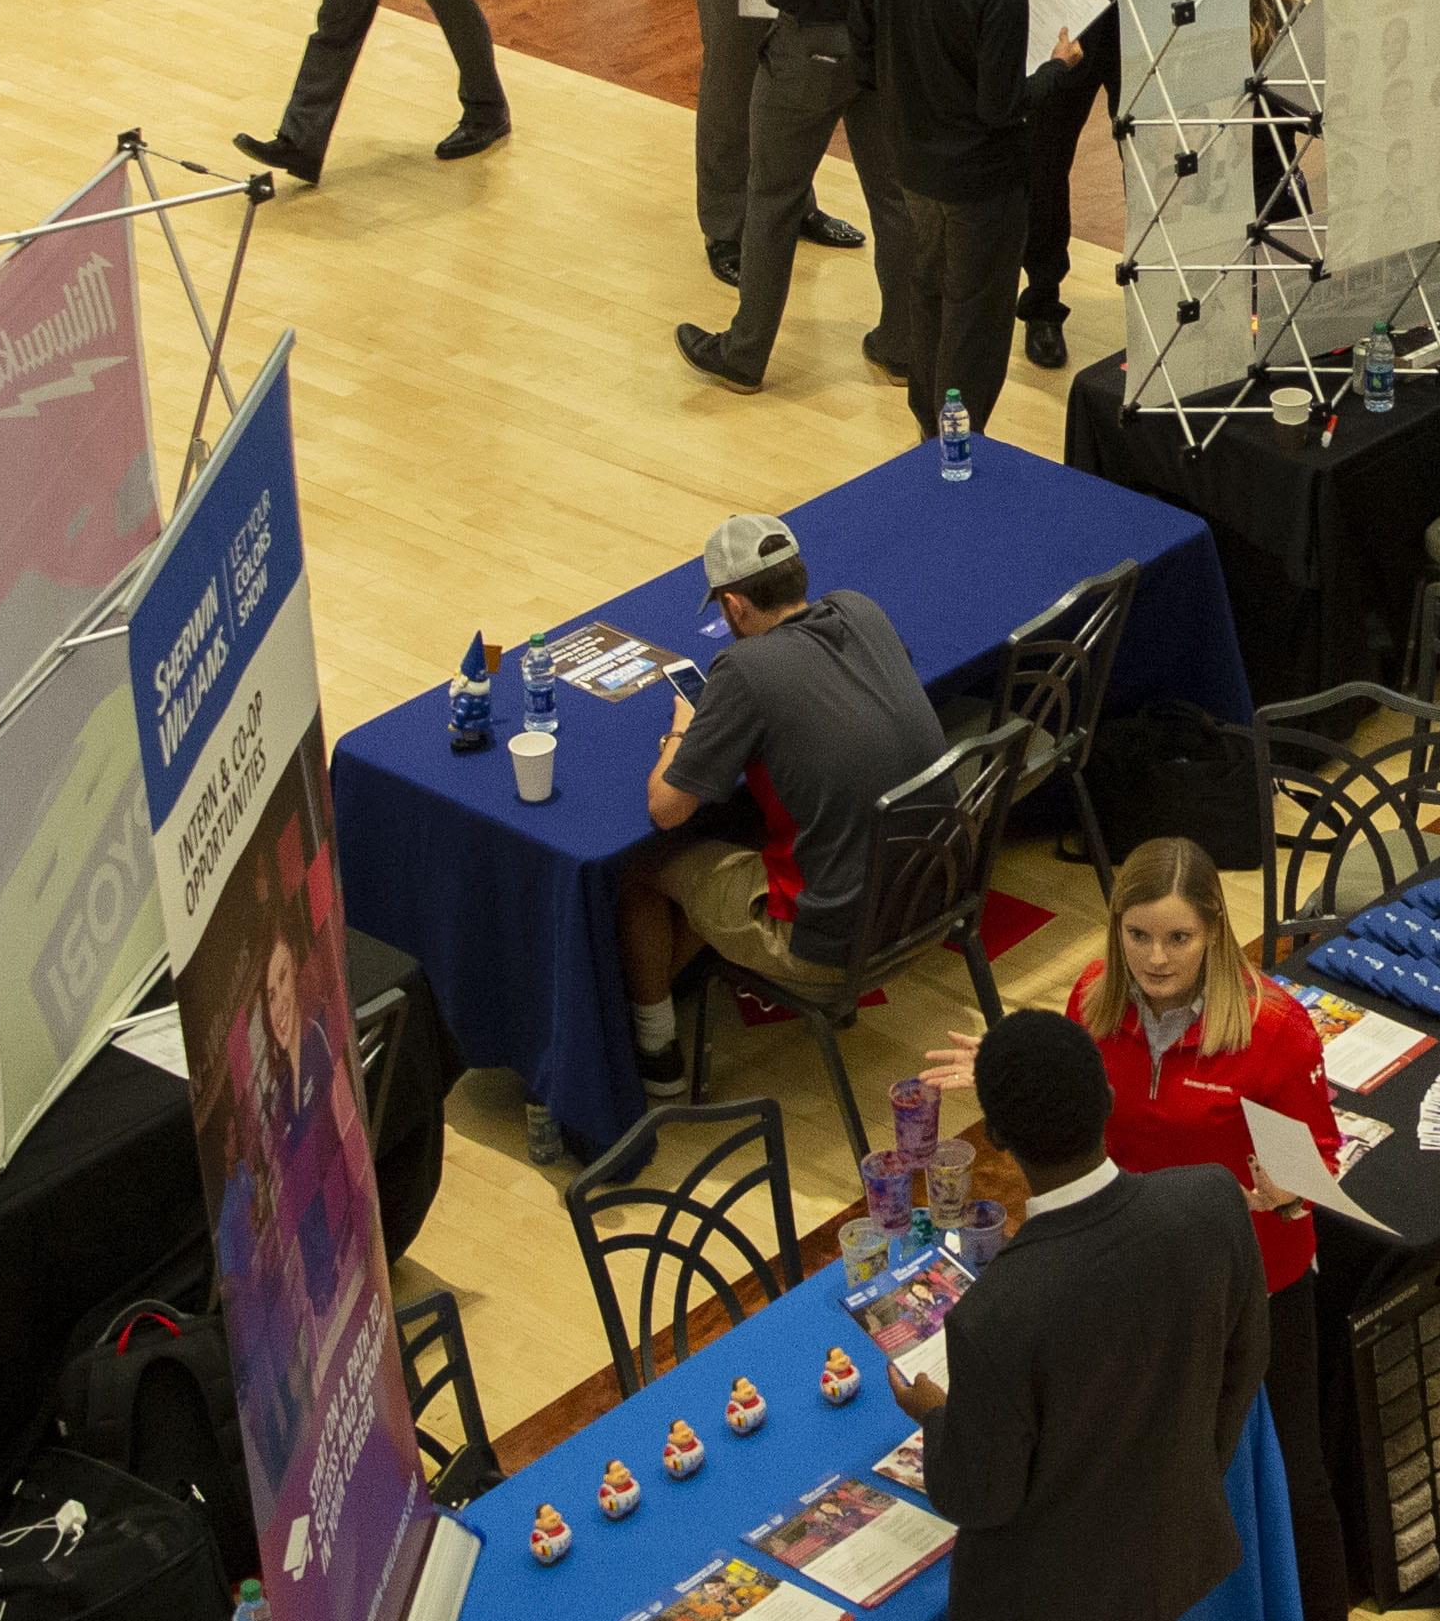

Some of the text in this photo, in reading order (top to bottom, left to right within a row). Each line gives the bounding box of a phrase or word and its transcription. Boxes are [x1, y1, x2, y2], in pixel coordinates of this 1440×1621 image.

[229, 488, 272, 568] LET YOUR
[233, 525, 272, 596] COLORS
[154, 576, 223, 716] SHERWIN
[238, 574, 268, 628] SHOW
[158, 634, 228, 769] WILLIAMS
[178, 689, 263, 877] INTERN & CO-OP
[184, 737, 267, 917] OPPORTUNITIES
